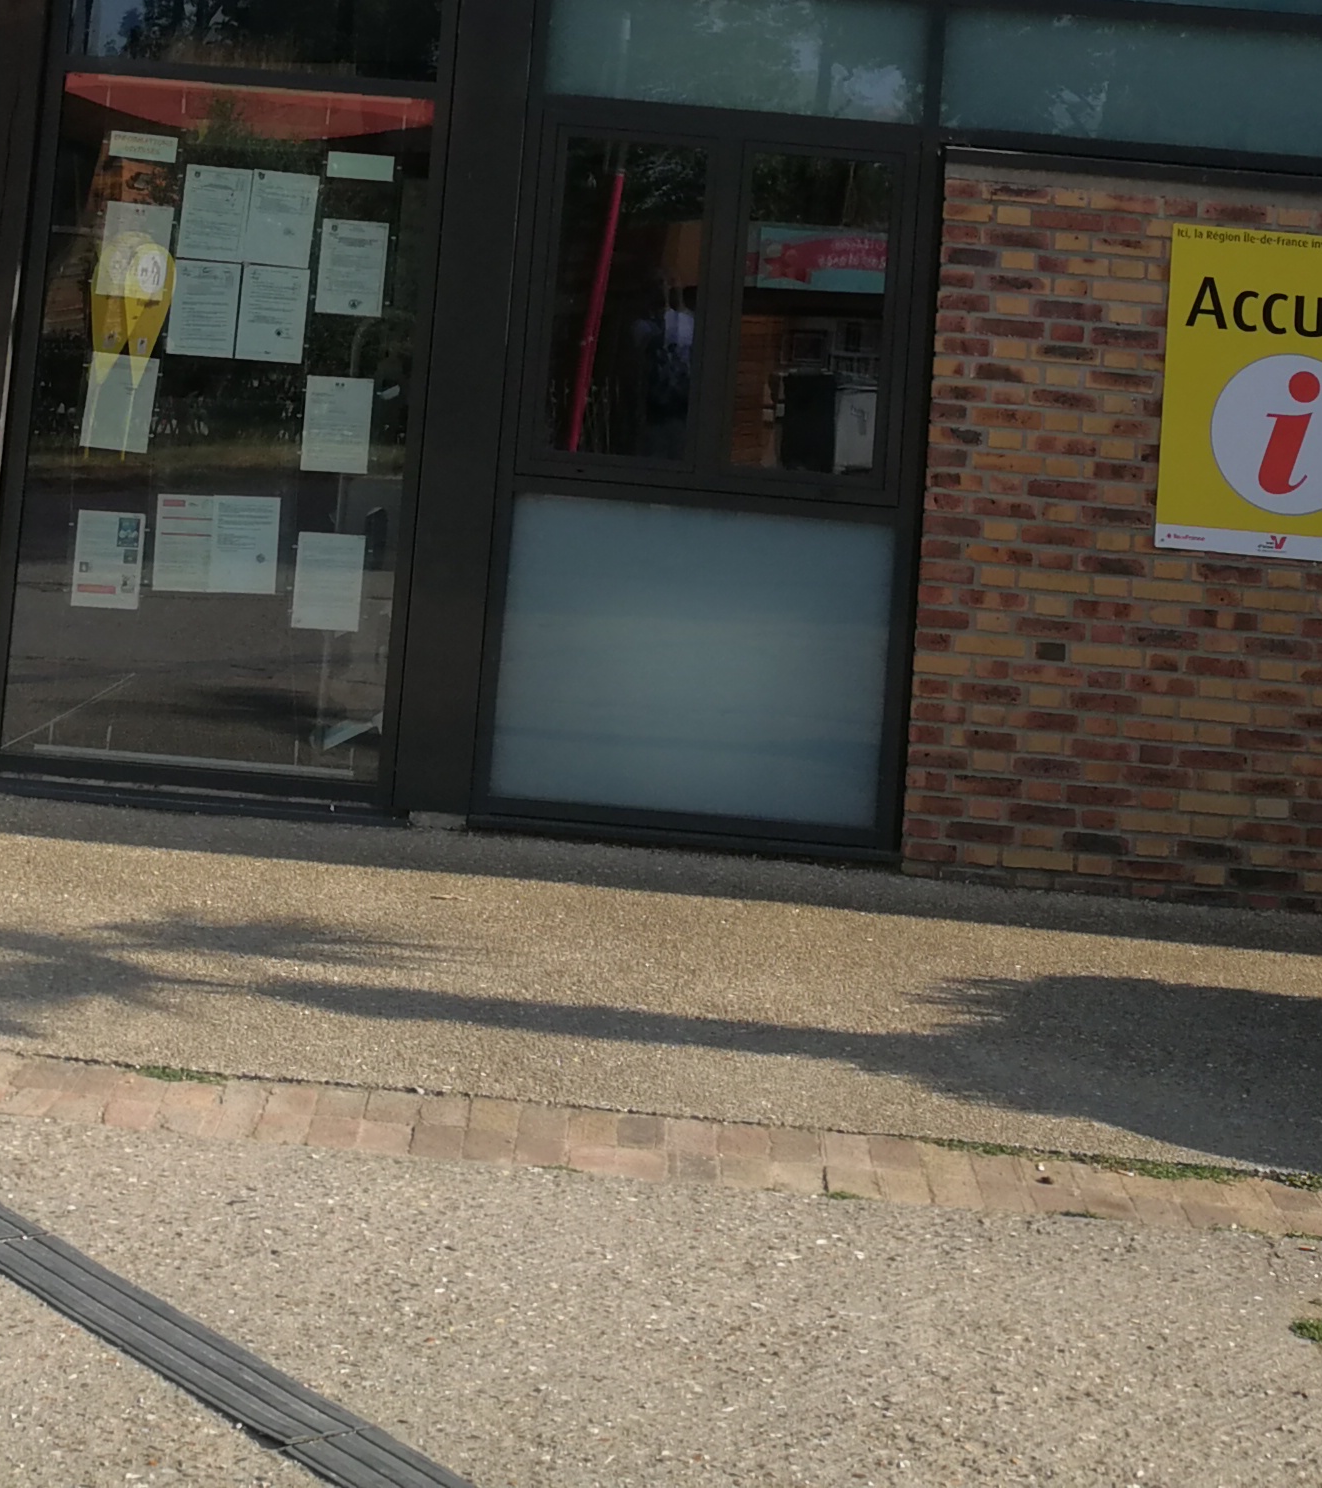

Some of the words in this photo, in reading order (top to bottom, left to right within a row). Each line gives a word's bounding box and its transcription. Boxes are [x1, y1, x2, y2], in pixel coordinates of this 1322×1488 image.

[1177, 228, 1191, 239] Ici,
[1194, 228, 1203, 239] la
[1206, 230, 1240, 243] Région
